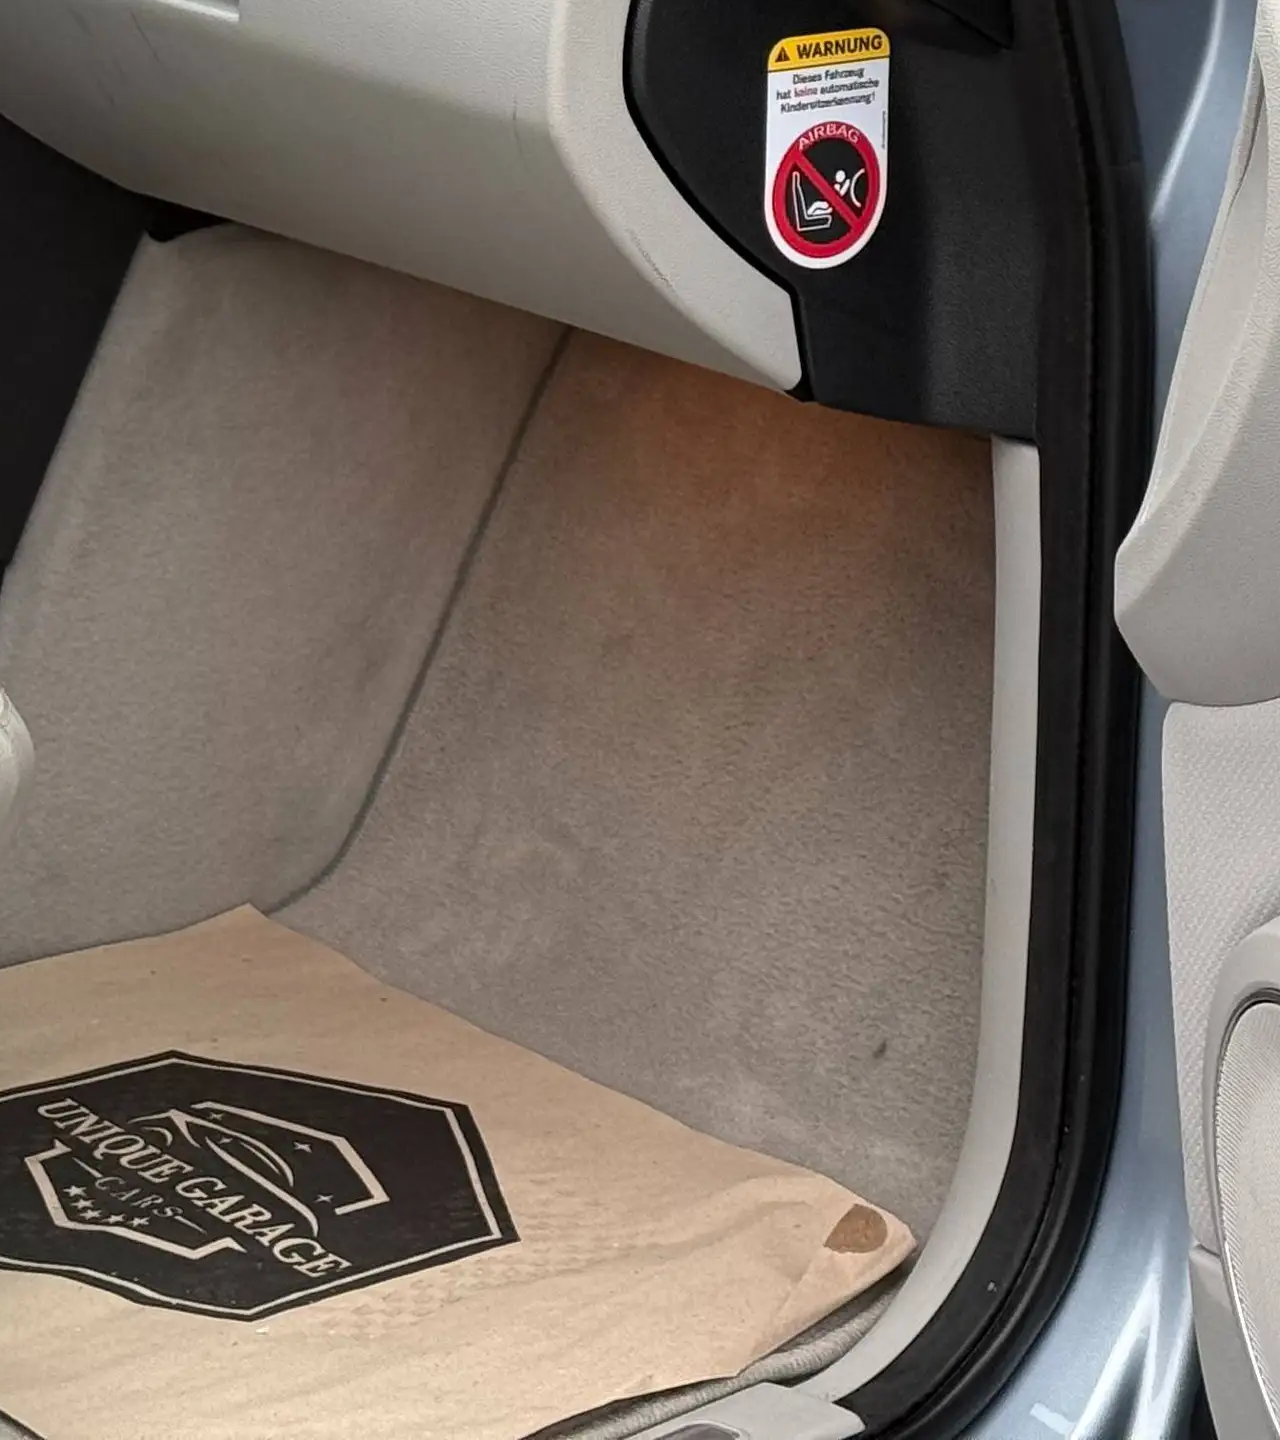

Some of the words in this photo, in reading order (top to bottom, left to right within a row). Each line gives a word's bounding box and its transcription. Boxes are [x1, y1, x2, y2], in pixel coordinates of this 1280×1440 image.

[796, 34, 883, 60] WARNUNG
[776, 89, 792, 101] hat
[793, 86, 819, 98] keine
[819, 77, 880, 95] automatische
[792, 73, 822, 85] Dieses
[824, 67, 865, 81] Fahrzeug
[798, 123, 861, 151] AIRBAG
[36, 1097, 195, 1184] UNIQUE
[174, 1176, 353, 1279] GARAGE
[94, 1175, 185, 1219] CARS
